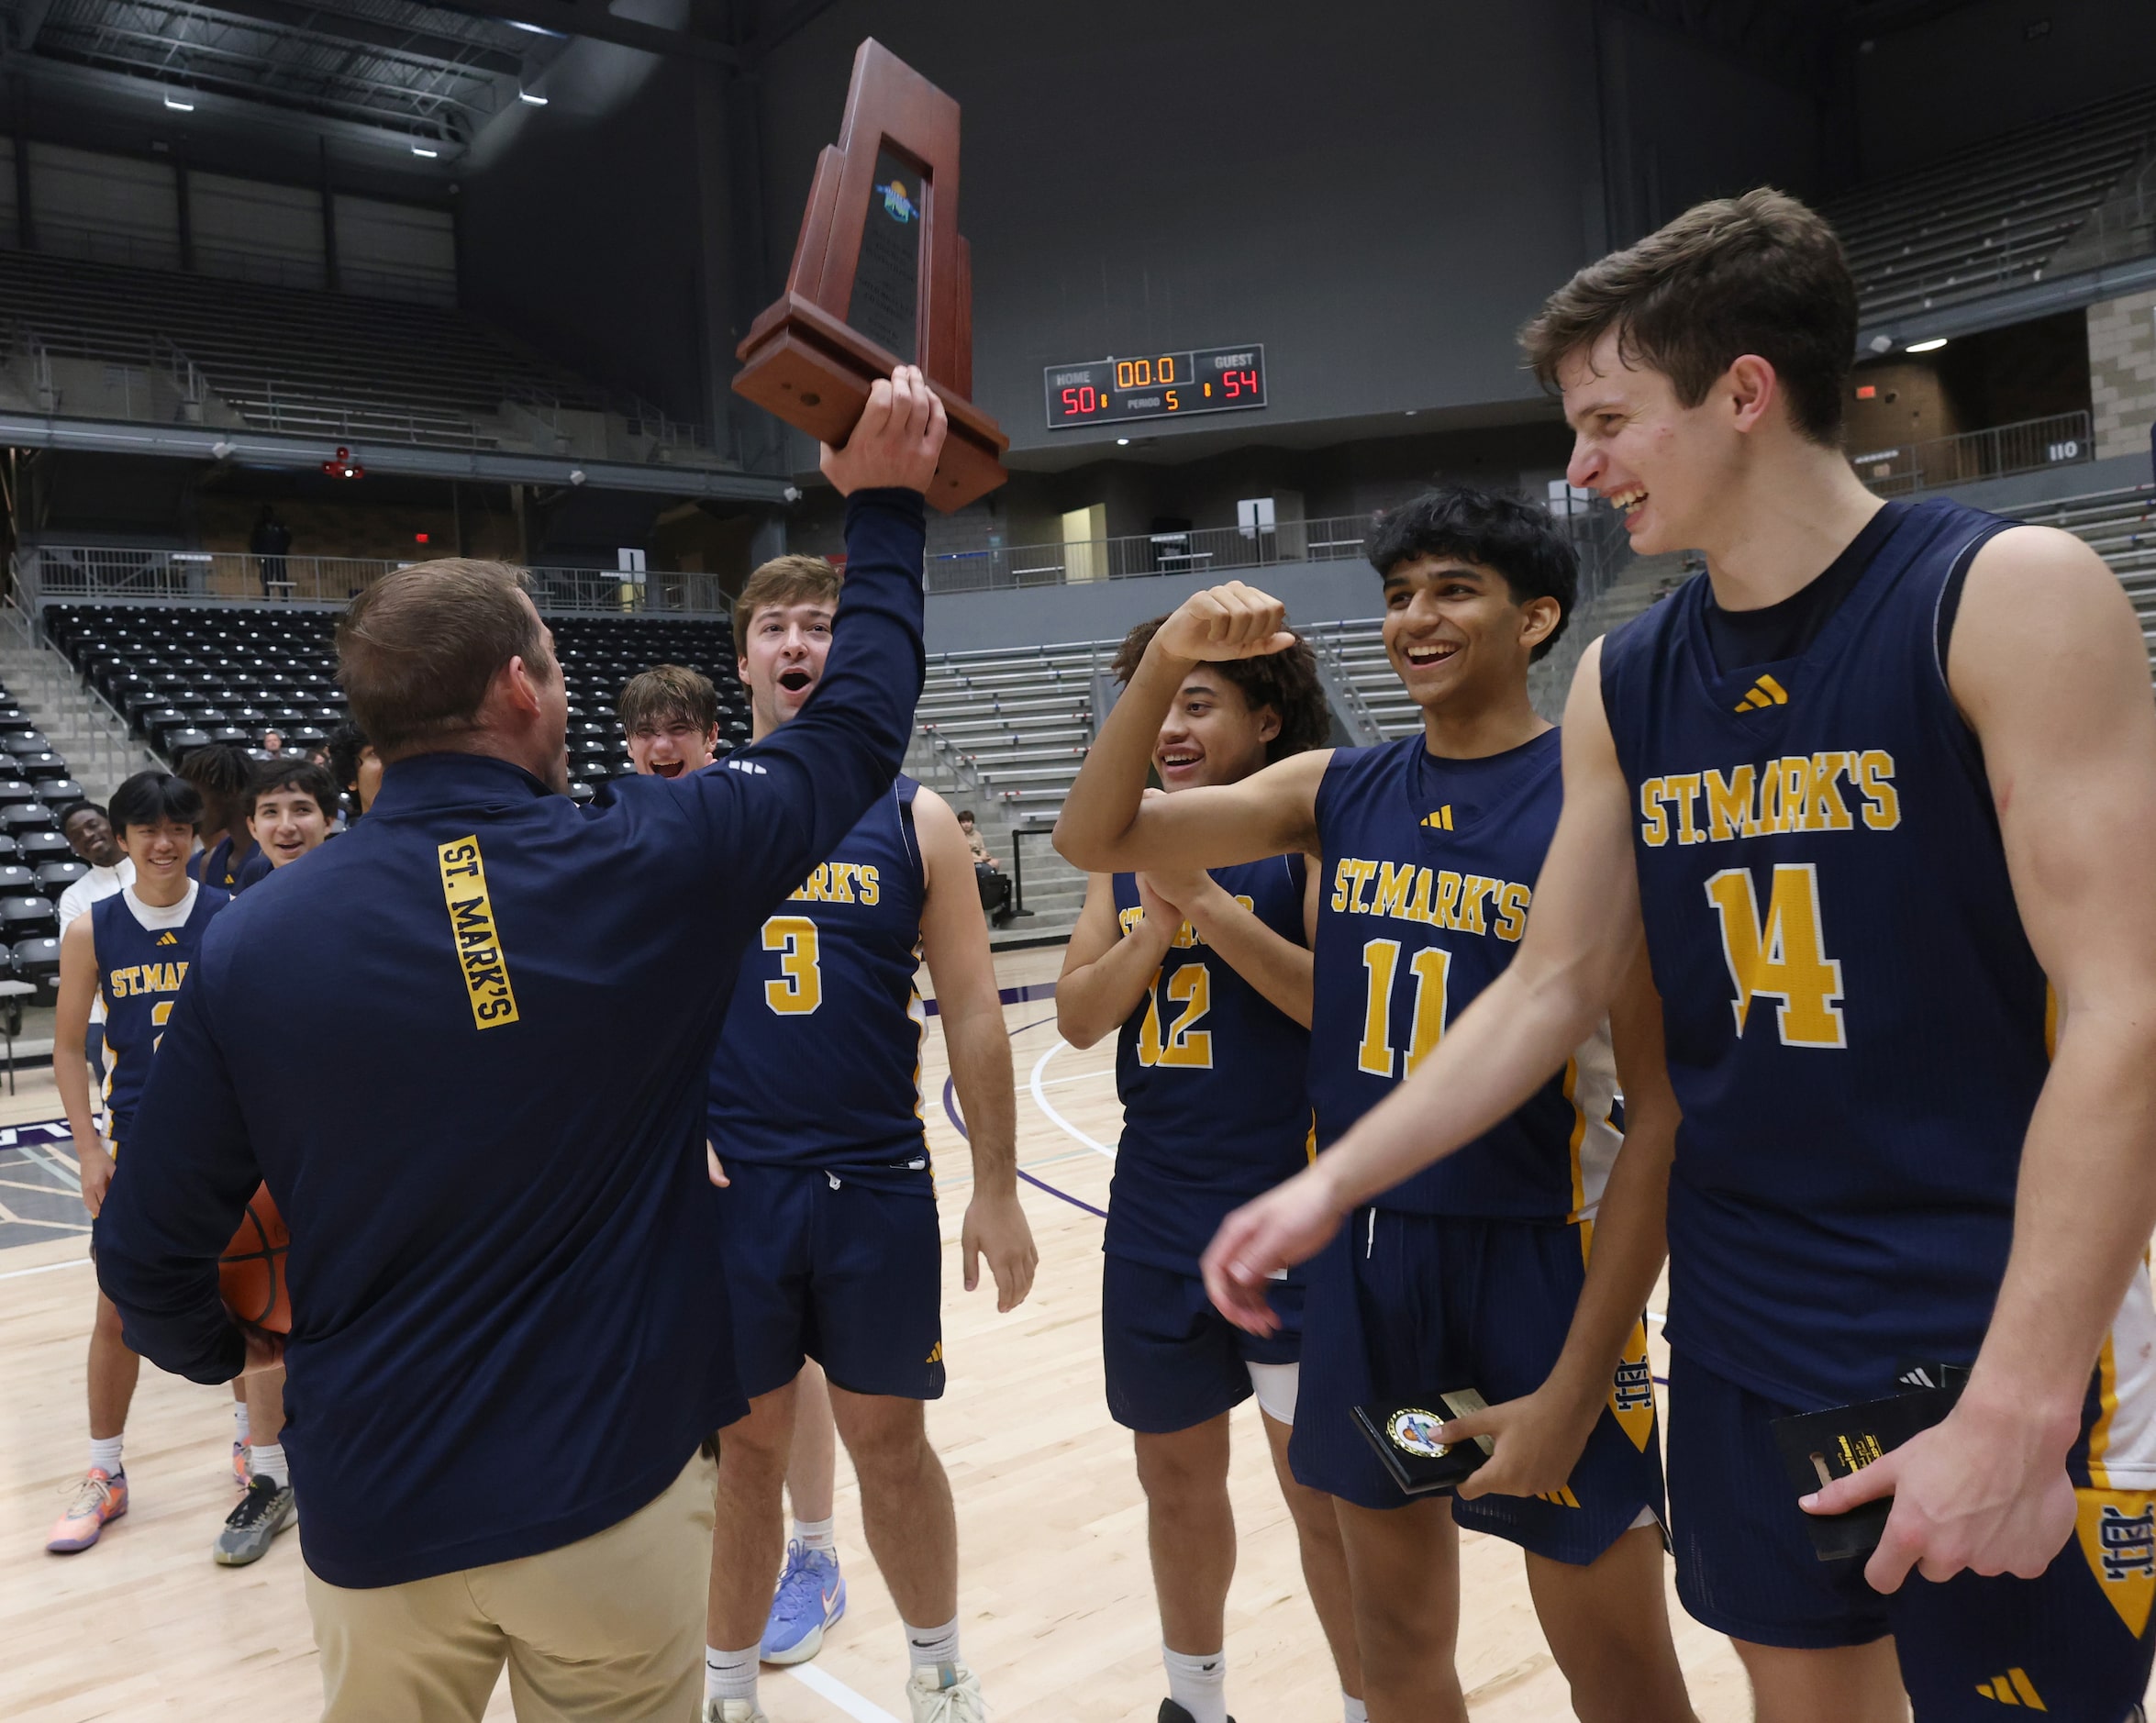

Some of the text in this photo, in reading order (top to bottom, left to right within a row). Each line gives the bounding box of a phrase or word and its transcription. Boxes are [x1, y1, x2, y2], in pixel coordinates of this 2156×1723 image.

[1117, 357, 1174, 388] 00.0
[1214, 353, 1254, 369] GUEST
[1056, 371, 1090, 386] HOME
[1222, 370, 1258, 398] 54
[1061, 386, 1096, 415] 50
[1127, 390, 1179, 410] PERIOD 5
[2050, 440, 2078, 461] 110
[443, 844, 513, 1021] ST. MARK'S
[761, 915, 823, 1016] 3
[1704, 862, 1848, 1050] 14
[1136, 962, 1214, 1070] 12
[1358, 938, 1452, 1081] 11
